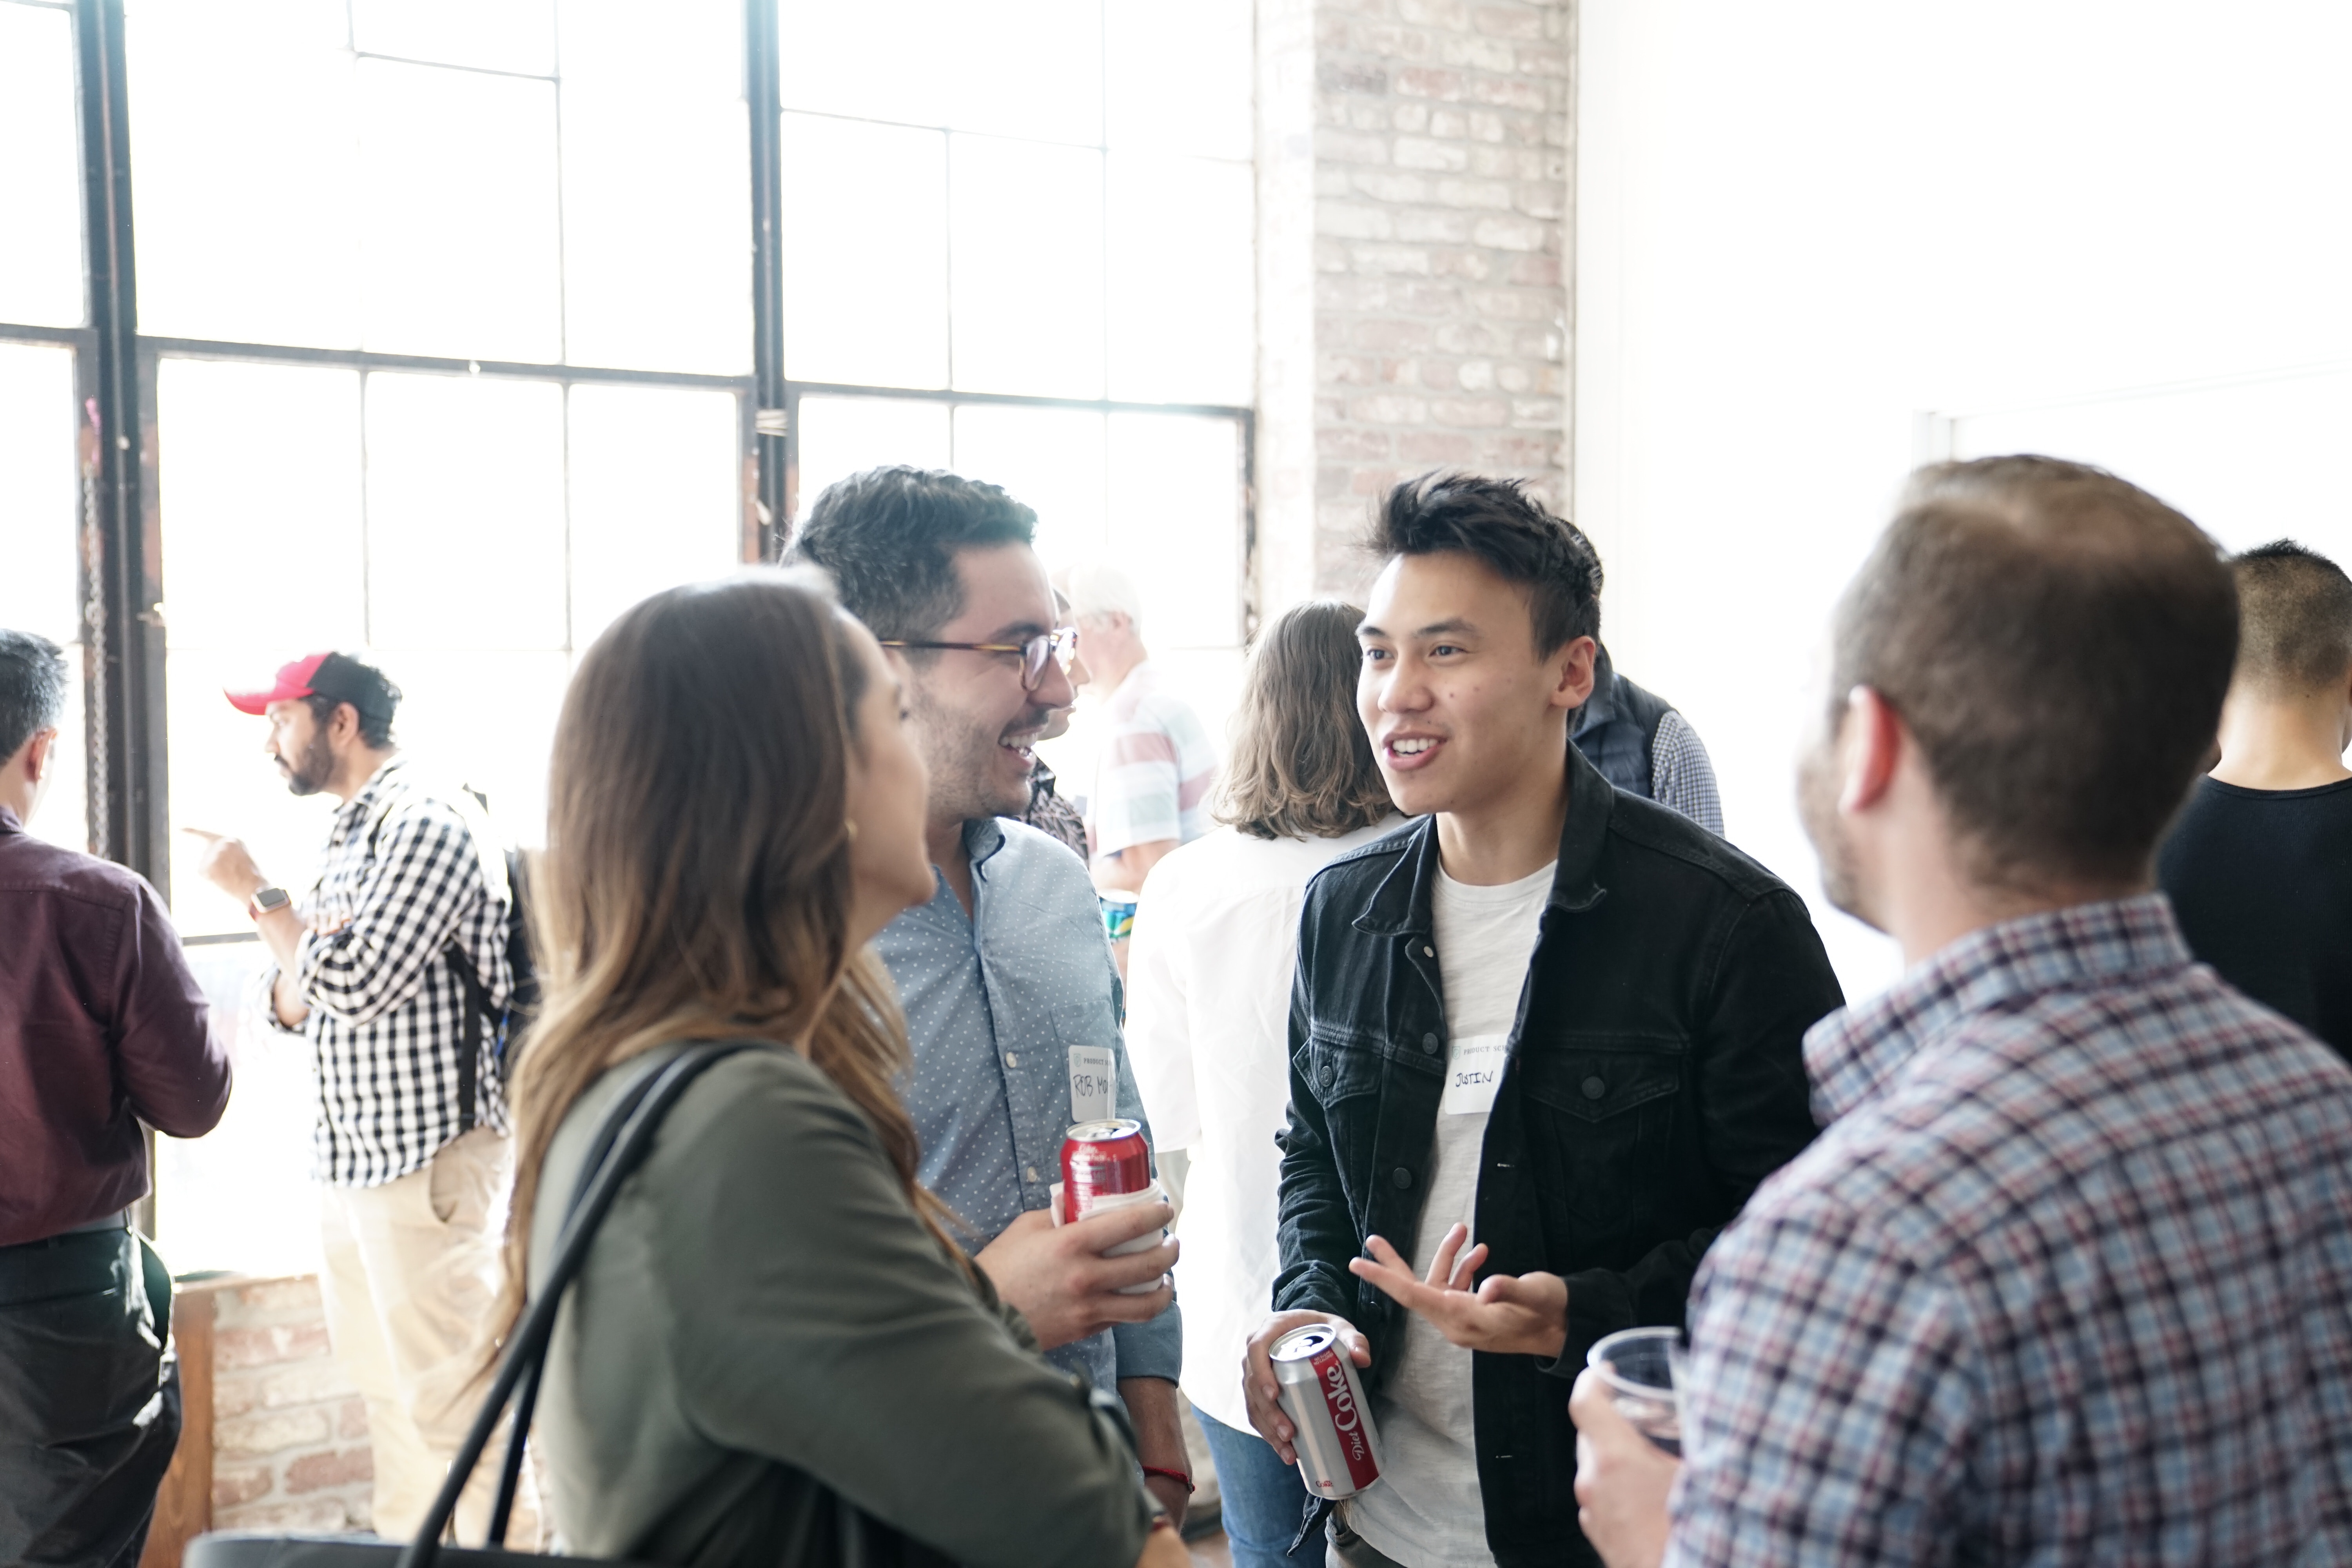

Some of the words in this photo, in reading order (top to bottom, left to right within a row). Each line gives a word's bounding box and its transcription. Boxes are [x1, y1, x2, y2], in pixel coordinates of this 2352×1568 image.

[1463, 1046, 1490, 1055] PRODUCT
[1073, 1074, 1093, 1098] ROB
[1455, 1070, 1493, 1087] JUSTIN
[1327, 1359, 1357, 1431] Coke
[1348, 1432, 1364, 1461] Diet
